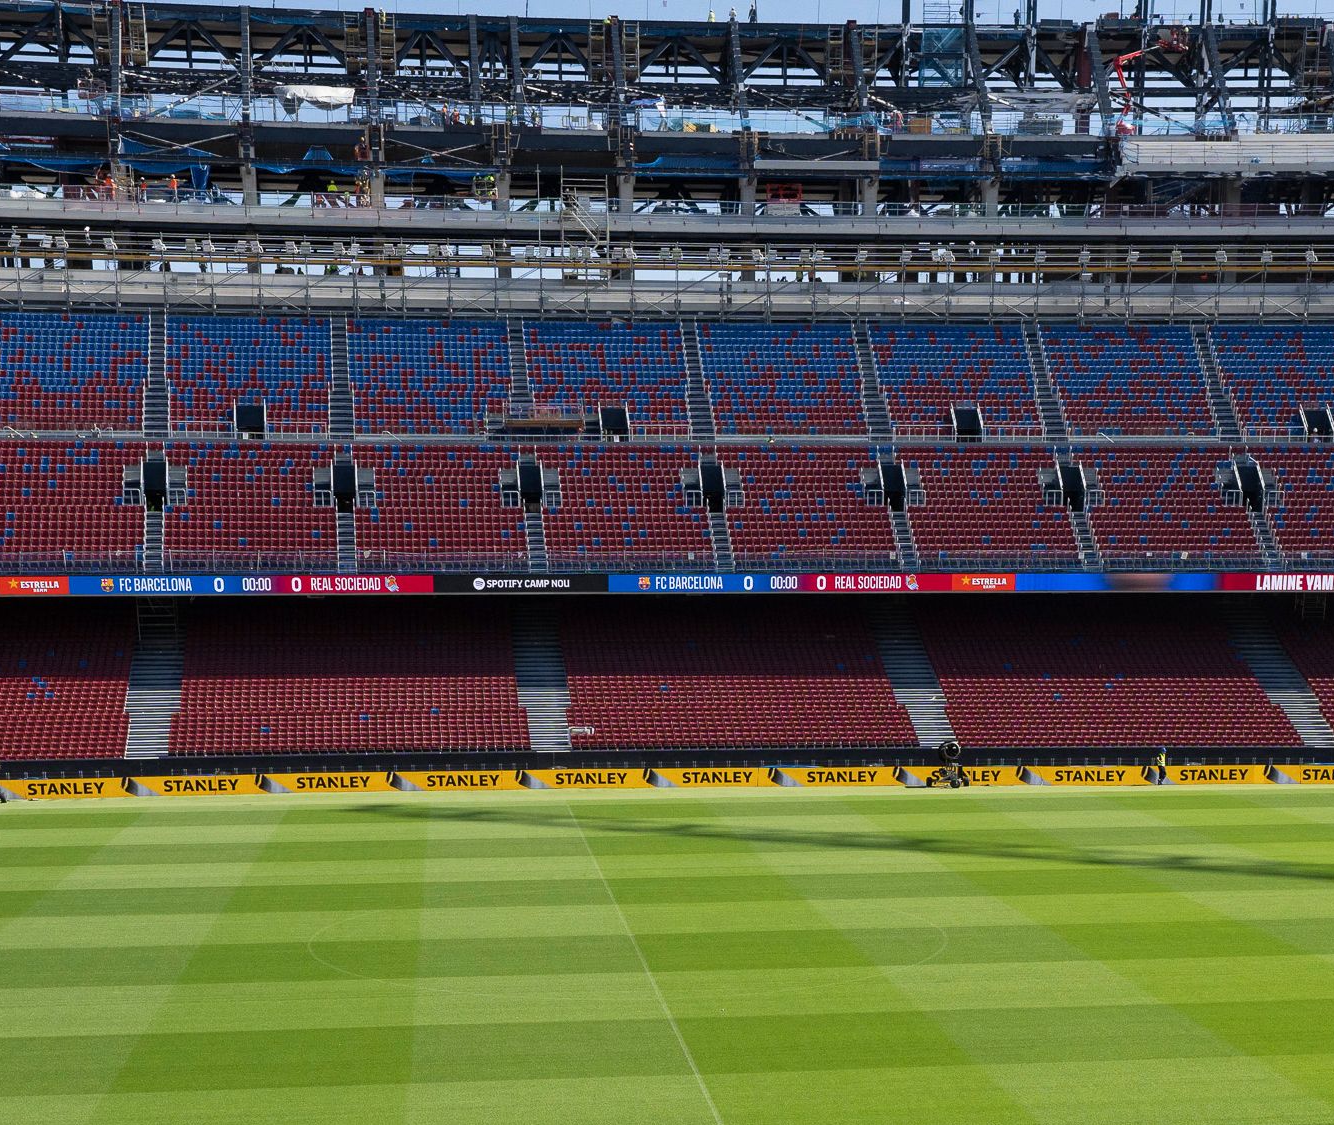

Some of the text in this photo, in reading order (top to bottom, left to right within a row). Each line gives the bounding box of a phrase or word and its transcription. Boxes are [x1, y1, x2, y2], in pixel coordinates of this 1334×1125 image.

[120, 578, 380, 592] FC BARCELONA 0 00:00 0 REAL SOCIEDAD
[487, 580, 522, 588] SPOTIFY
[656, 576, 901, 590] FC BARCELONA 0 00:00 0 REAL SOCIEDAD
[972, 578, 1006, 586] ESTRELLA
[1256, 575, 1303, 590] LAMINE
[427, 775, 499, 787] STANLEY
[556, 773, 627, 784] STANLEY
[683, 772, 752, 783] STANLEY
[808, 771, 877, 782] STANLEY
[1055, 771, 1125, 781] STANLEY
[1180, 769, 1248, 781] STANLEY
[164, 779, 238, 792] STANLEY
[297, 776, 369, 788] STANLEY
[28, 782, 104, 795] STANLEY
